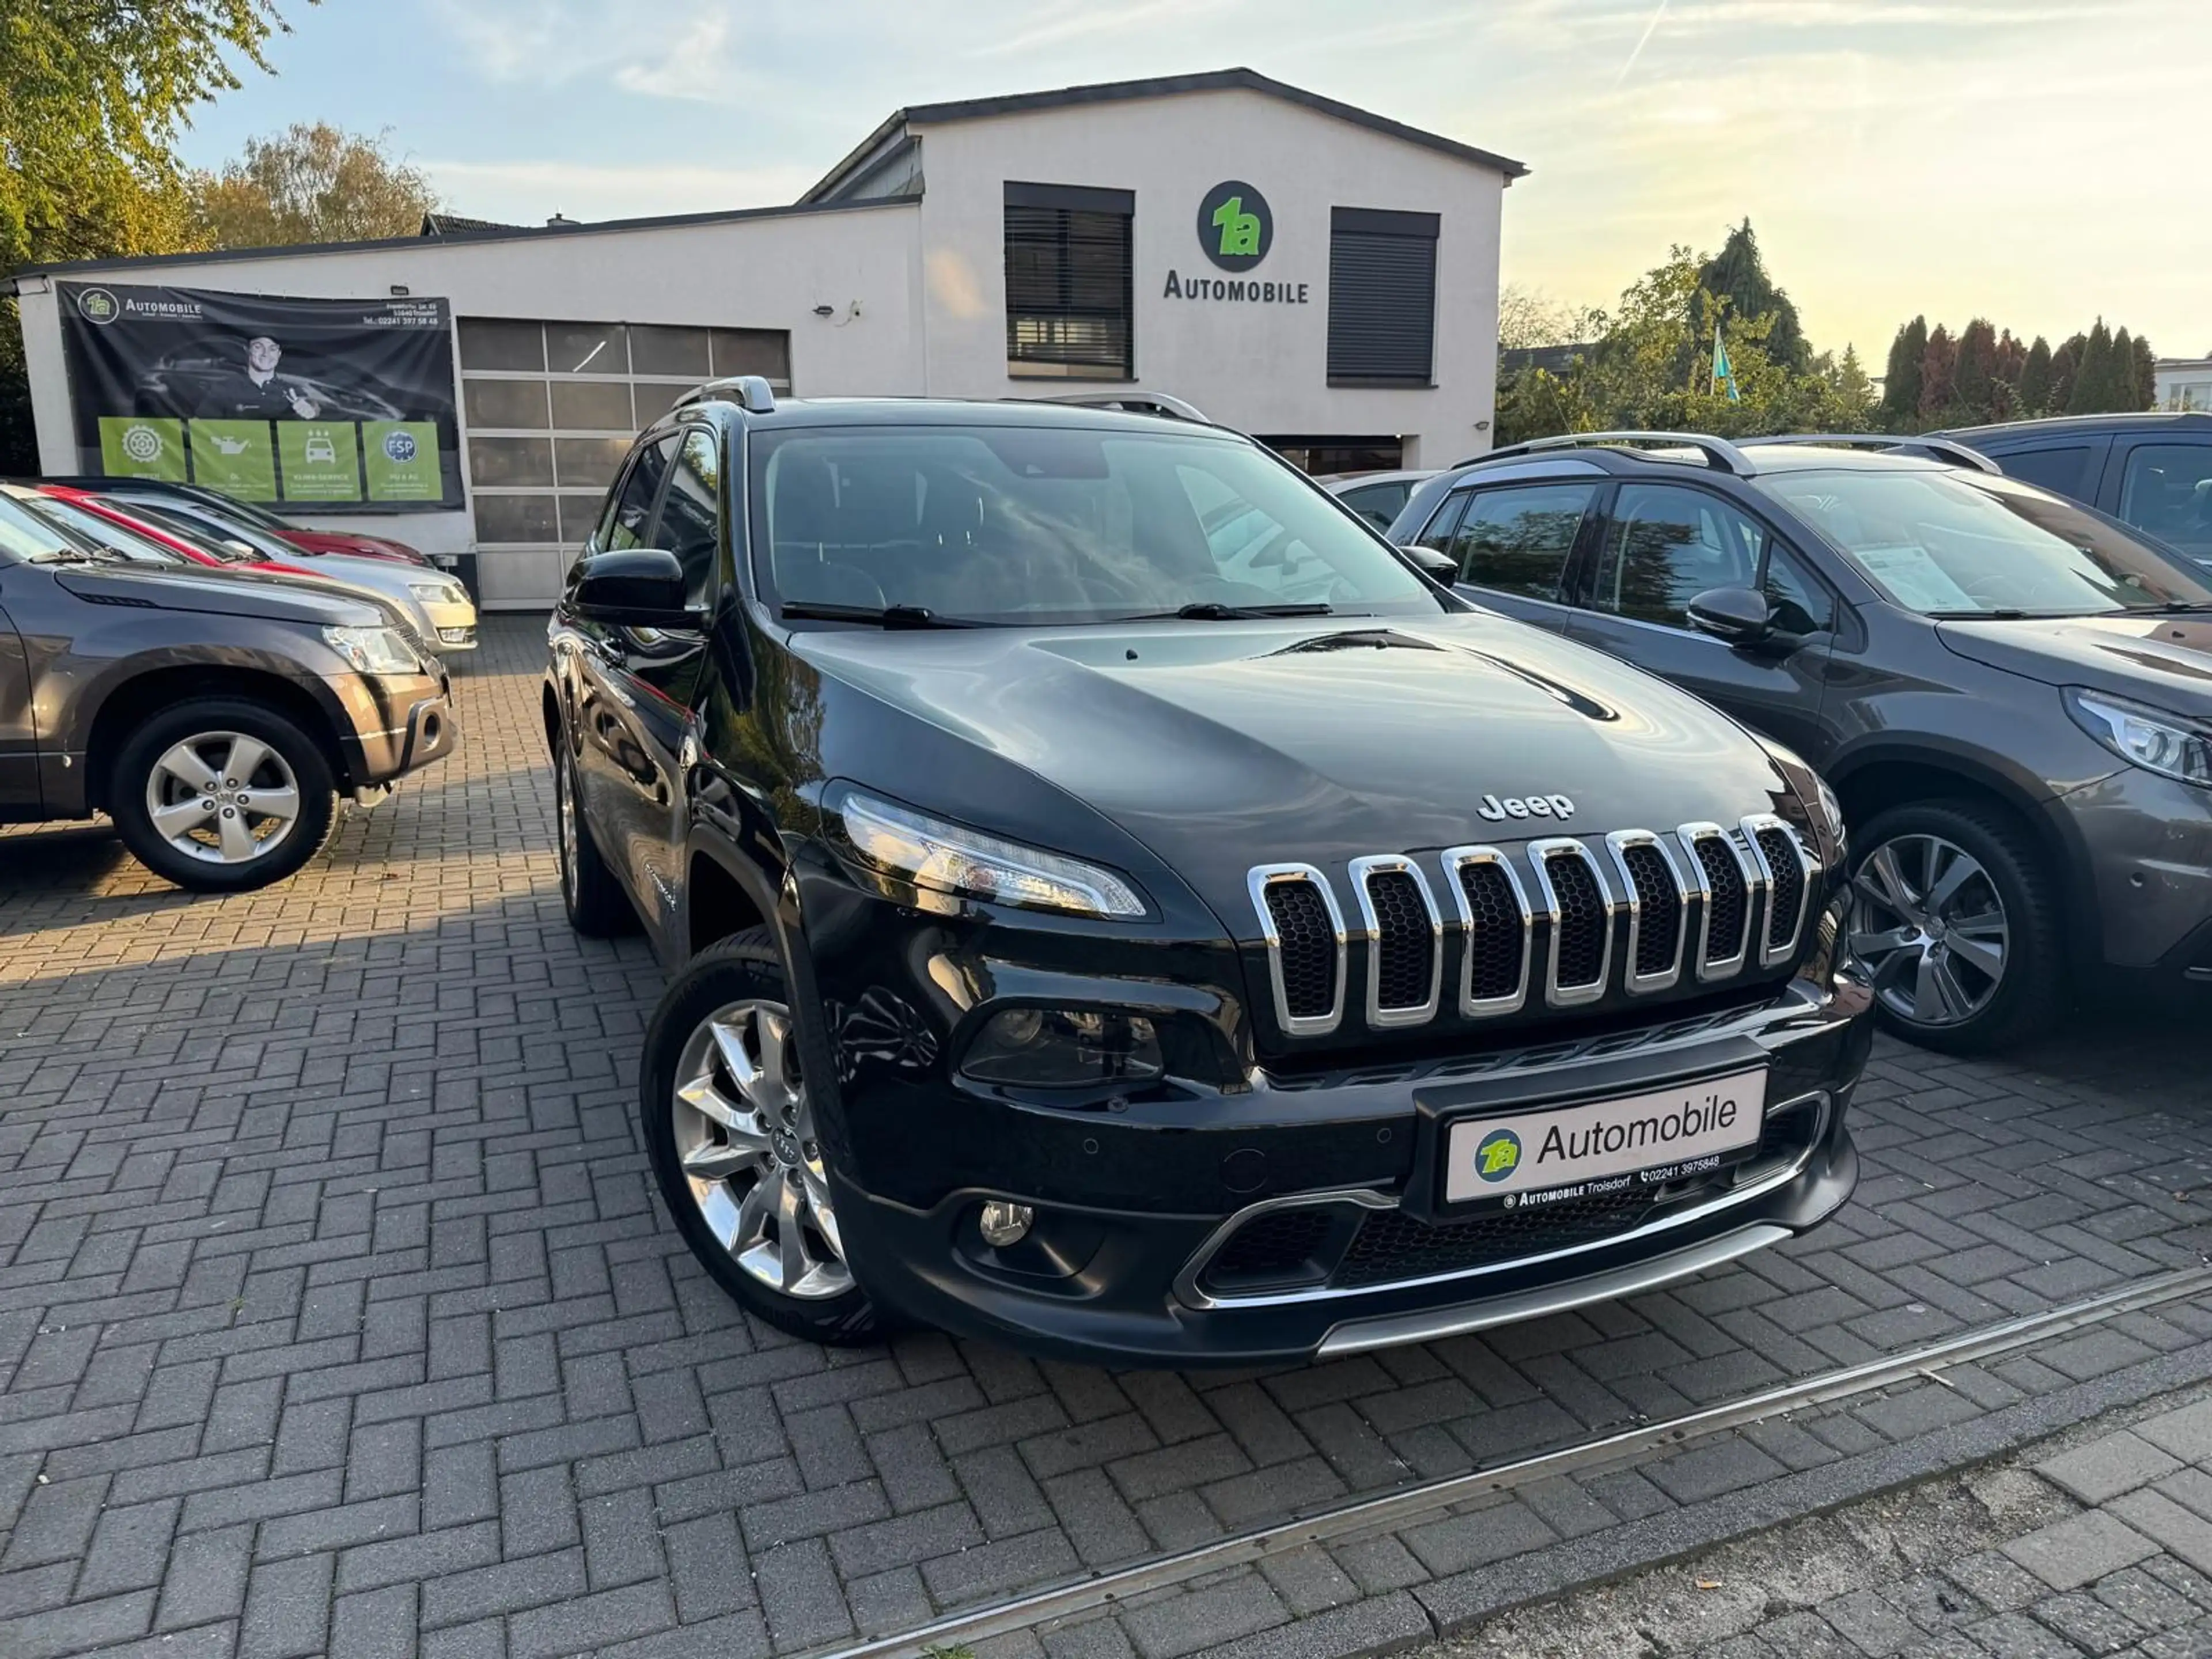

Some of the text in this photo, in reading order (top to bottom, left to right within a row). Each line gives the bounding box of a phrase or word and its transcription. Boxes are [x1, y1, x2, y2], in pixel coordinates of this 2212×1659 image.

[1213, 196, 1260, 255] 1a
[1163, 269, 1309, 304] AUTOMOBILE
[126, 298, 202, 313] AUTOMOBILE
[388, 441, 413, 453] FSP
[1477, 794, 1574, 821] Jeep
[1480, 1094, 1737, 1173] 1a Automobile
[1518, 1186, 1584, 1207] AUTOMOBILE
[1587, 1175, 1631, 1194] Troisdorf
[1649, 1165, 1679, 1181] 02241
